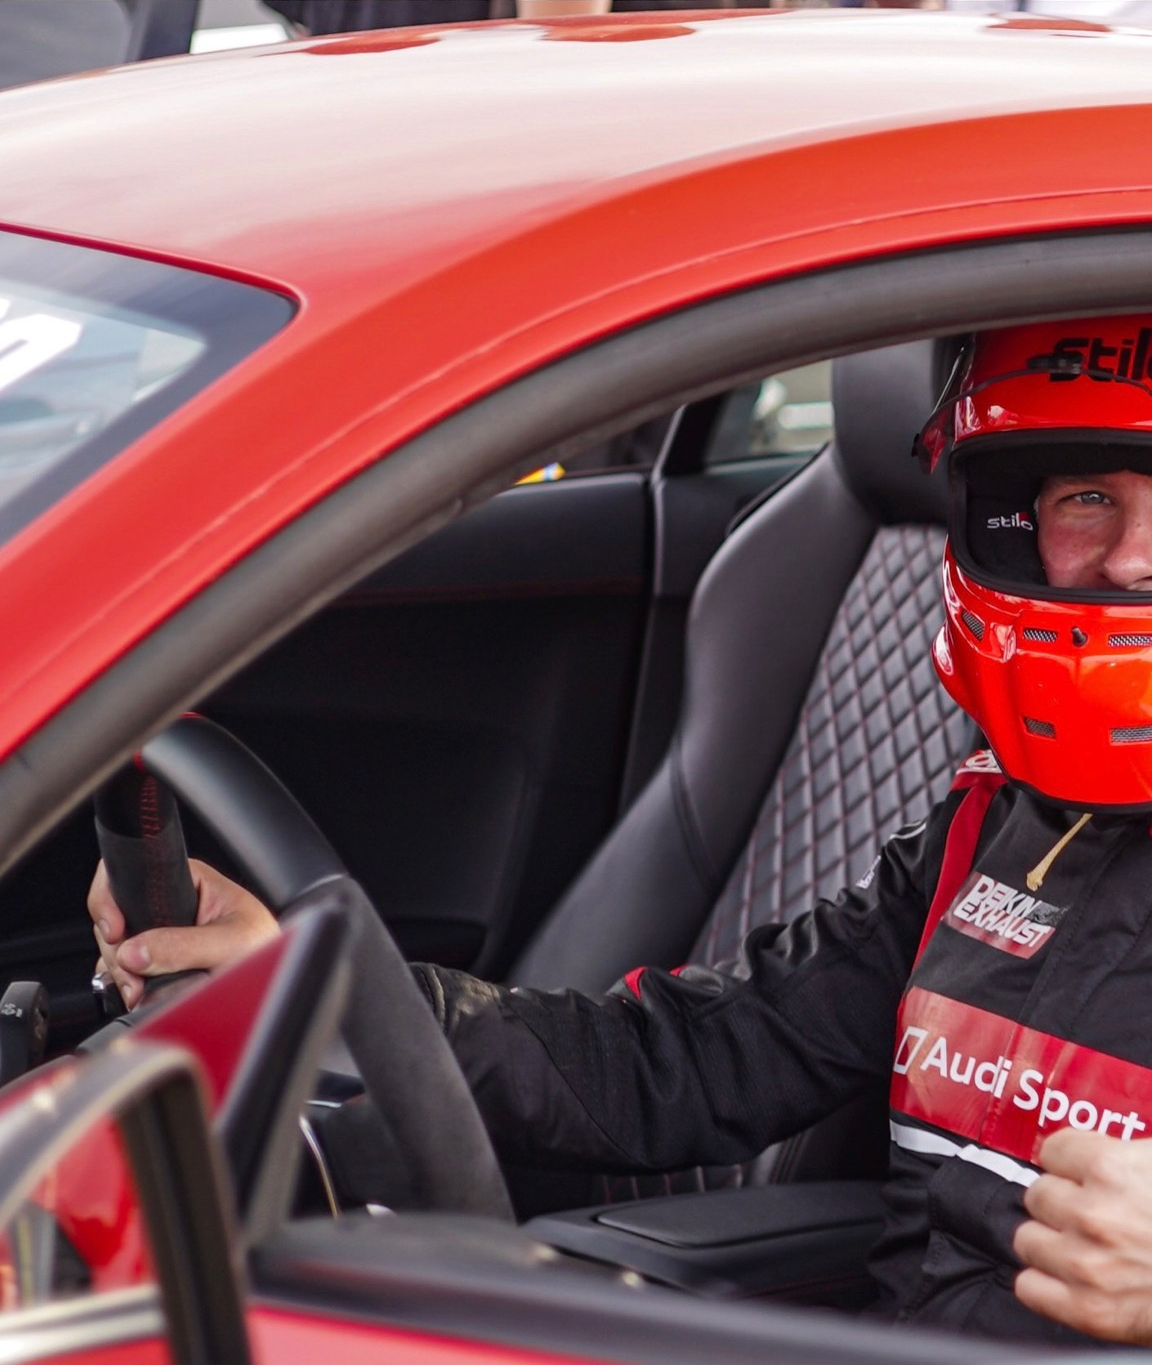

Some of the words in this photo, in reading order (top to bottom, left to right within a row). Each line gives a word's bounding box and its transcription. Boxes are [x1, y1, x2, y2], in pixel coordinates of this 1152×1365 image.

[953, 901, 1052, 948] EXHAUST
[919, 1035, 1013, 1099] Audi
[1013, 1068, 1147, 1142] Sport
